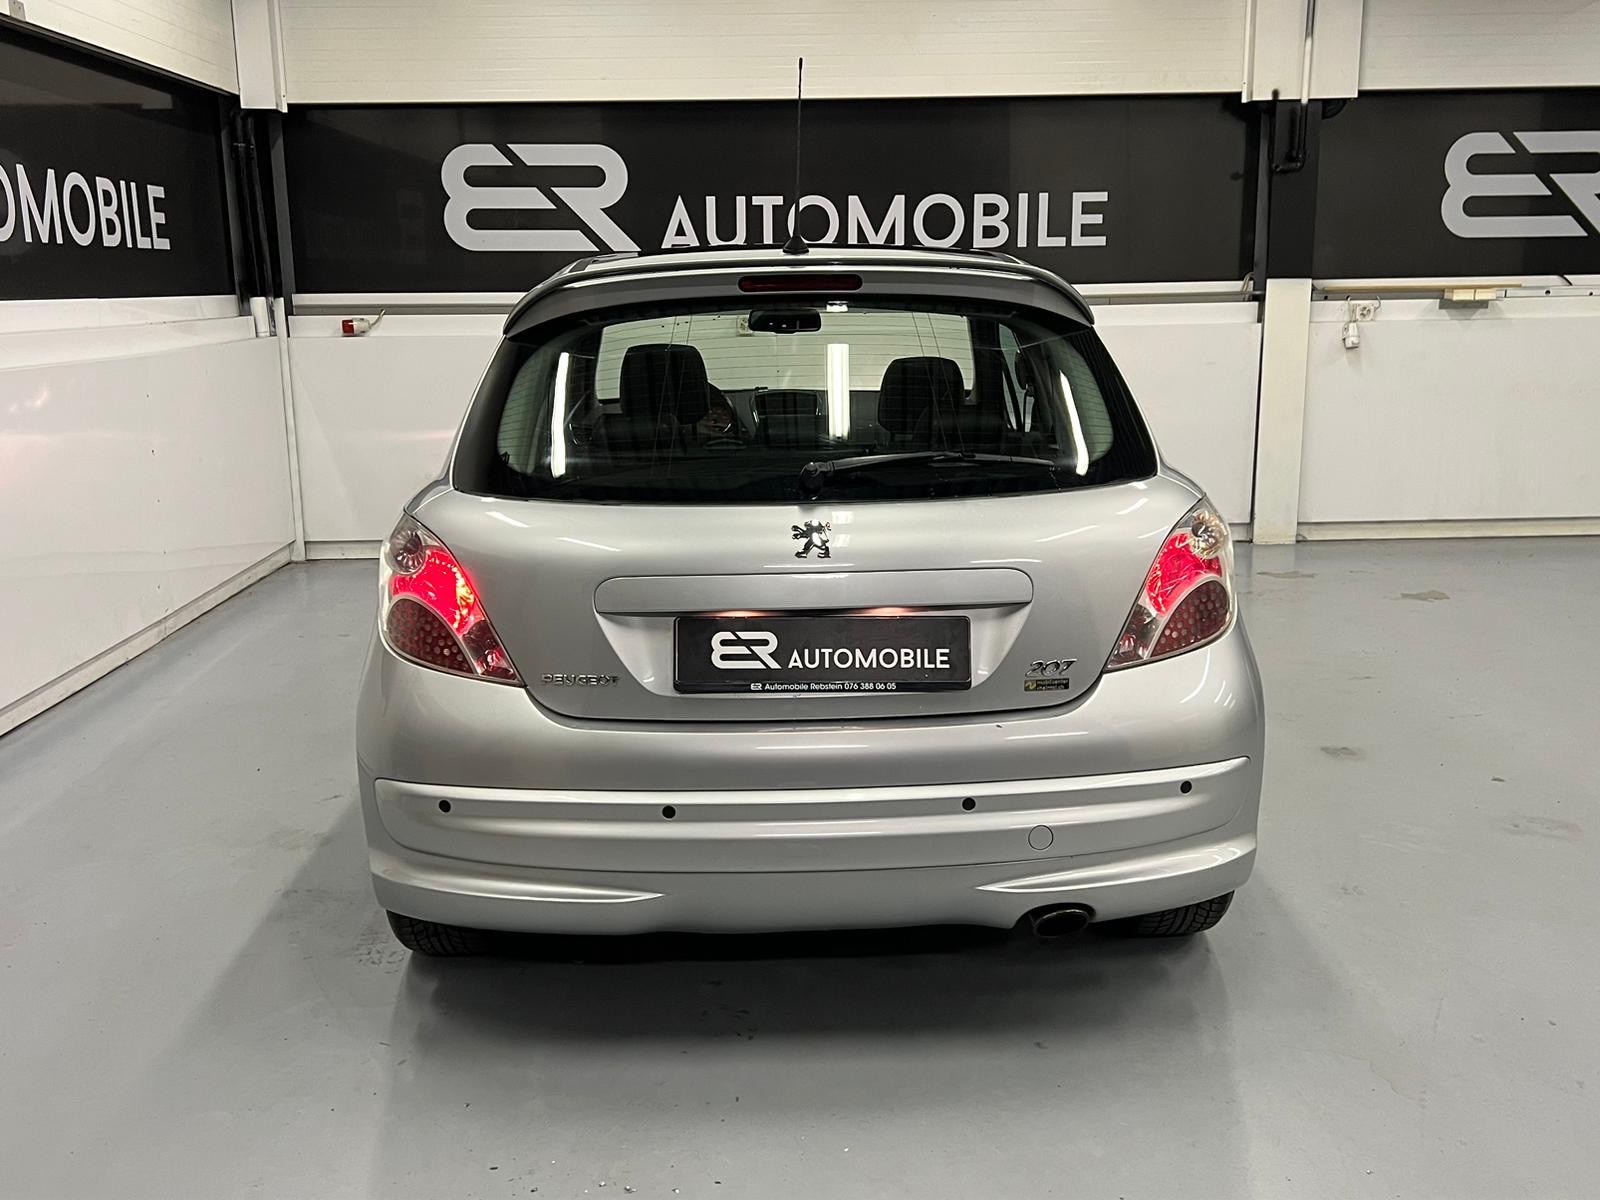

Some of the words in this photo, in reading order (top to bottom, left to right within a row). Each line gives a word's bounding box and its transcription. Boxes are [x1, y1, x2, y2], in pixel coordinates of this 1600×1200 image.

[661, 191, 1109, 249] AUTOMOBILE
[788, 648, 950, 669] AUTOMOBILE
[1025, 658, 1077, 678] 207
[541, 674, 618, 686] PEUGEOT
[764, 682, 808, 690] Automobile
[810, 682, 842, 690] Rebstein
[844, 682, 858, 690] 076
[860, 682, 874, 690] 388
